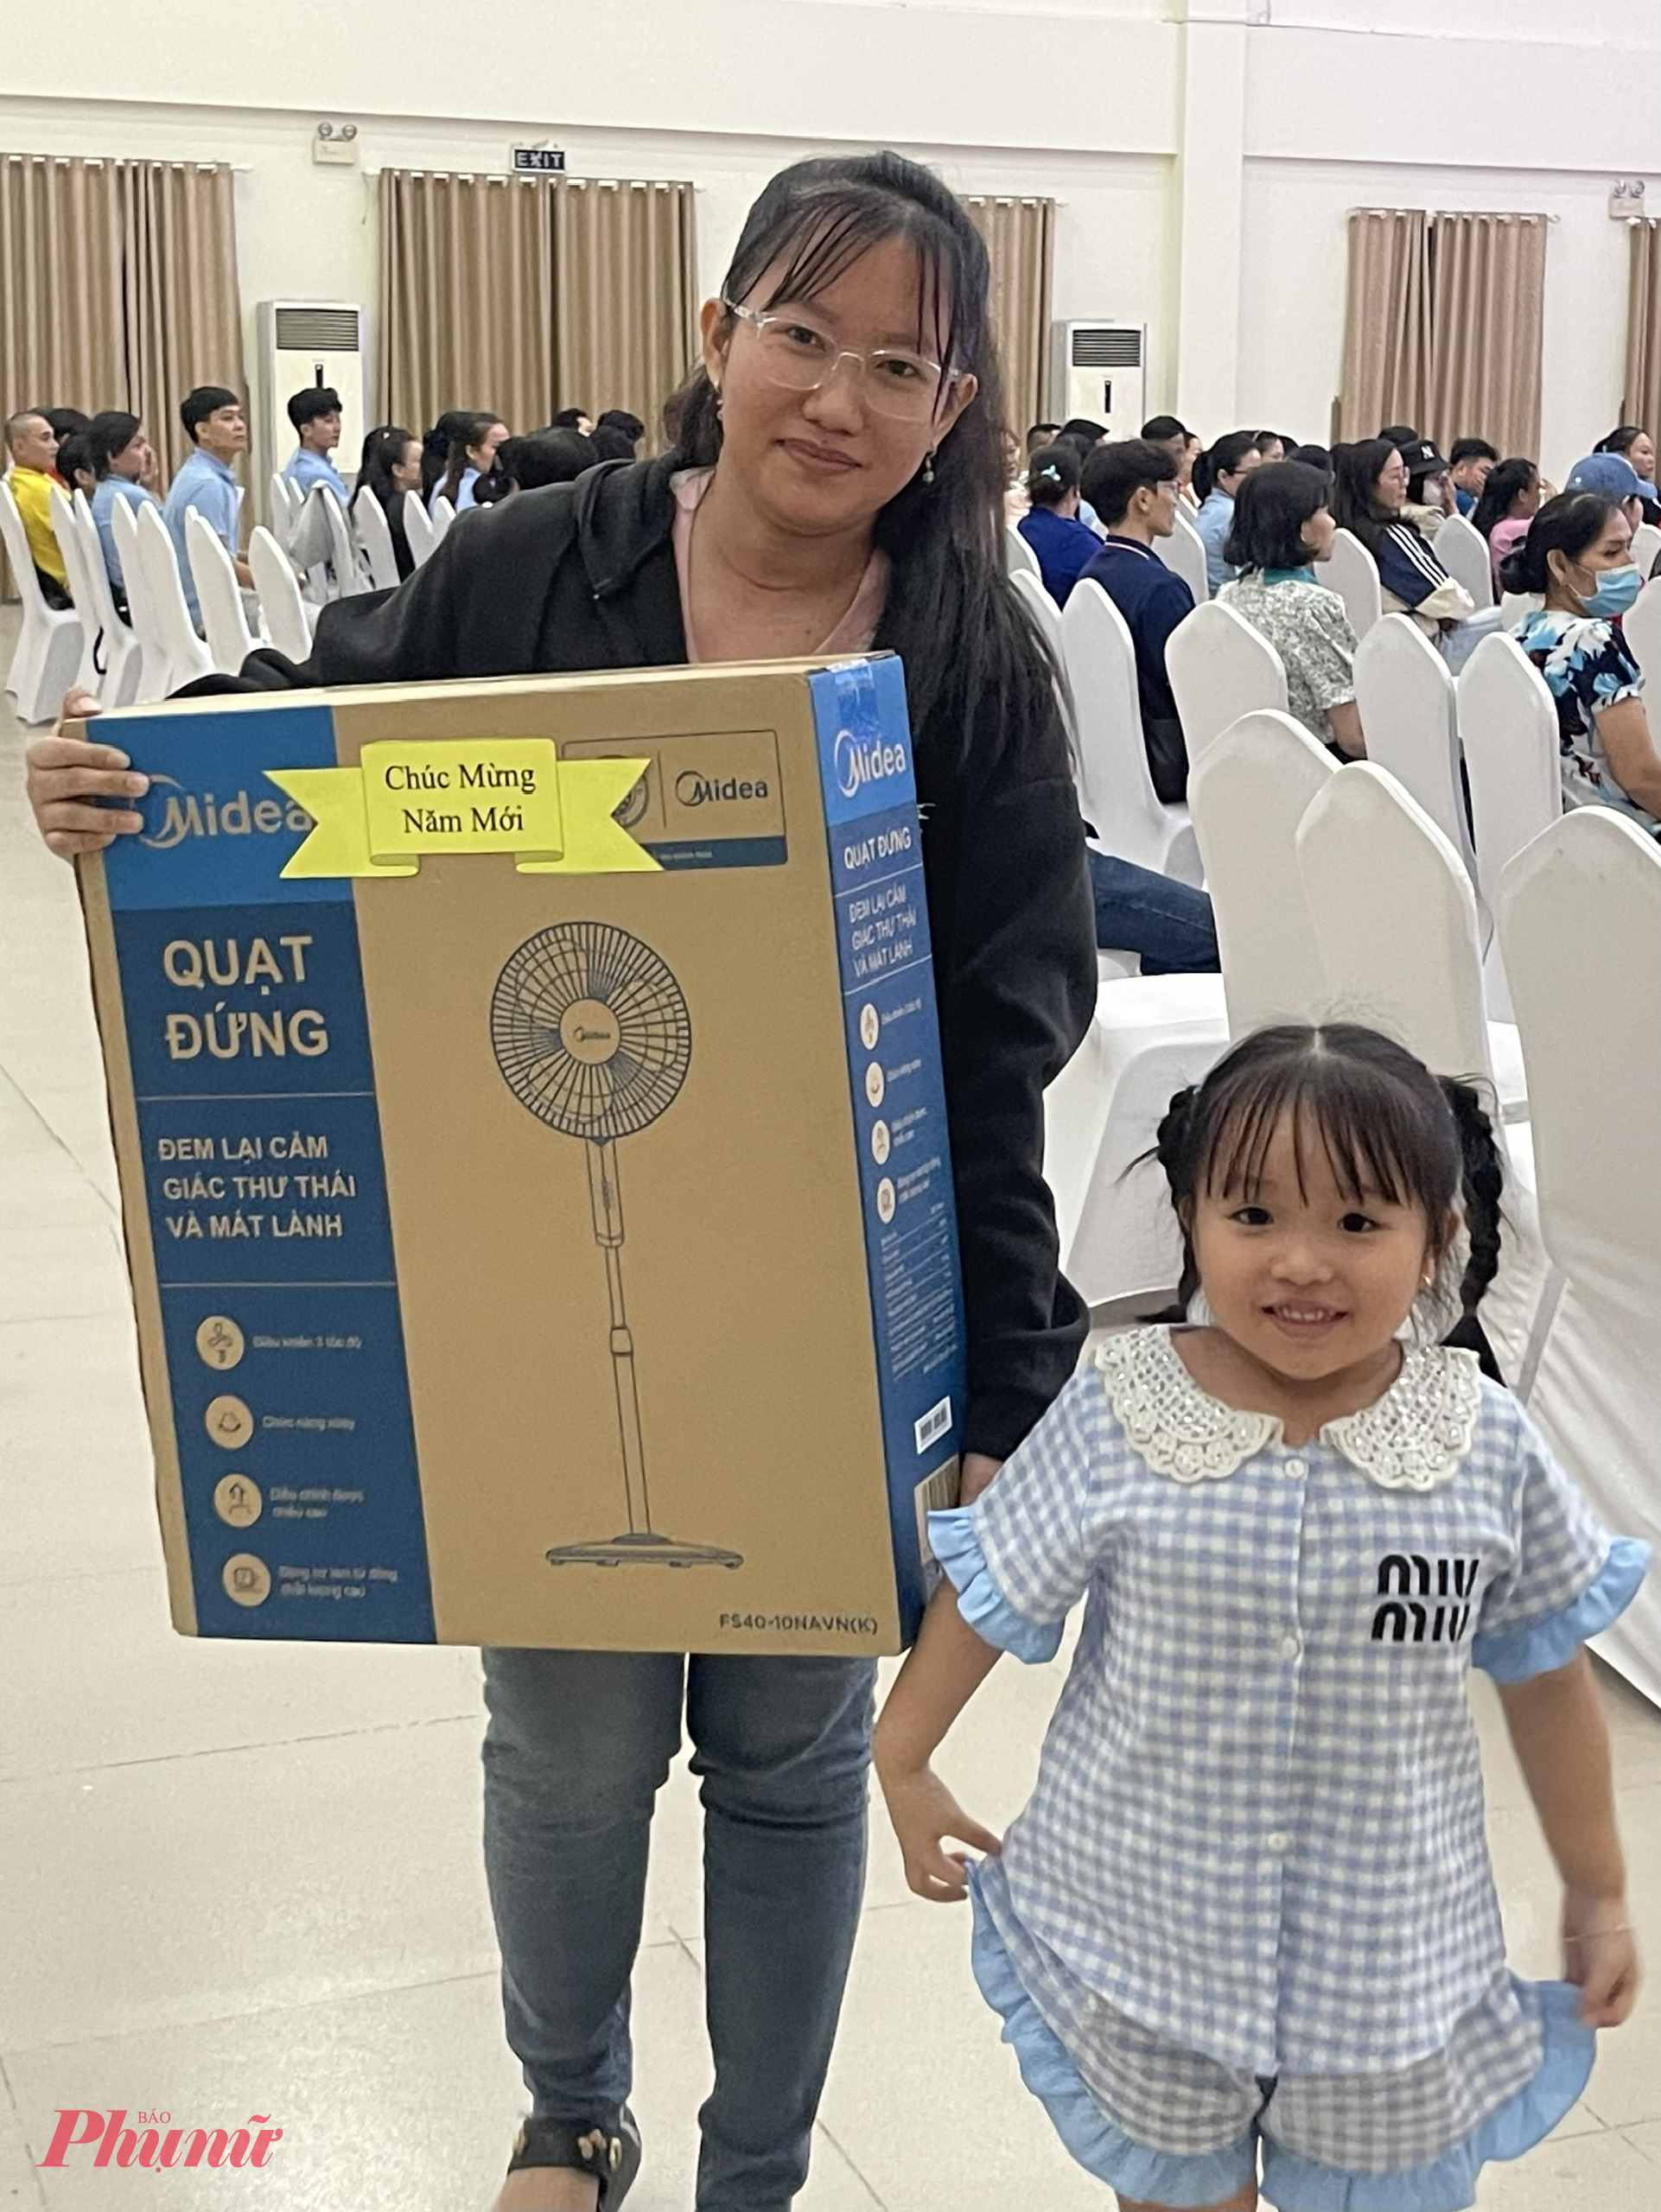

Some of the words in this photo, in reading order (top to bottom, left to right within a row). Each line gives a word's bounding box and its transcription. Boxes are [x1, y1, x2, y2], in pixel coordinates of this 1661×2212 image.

[517, 152, 563, 168] EXIT
[385, 765, 450, 790] Chúc
[458, 762, 536, 794] Mừng
[836, 729, 907, 798] Midea
[676, 771, 768, 807] Midea
[143, 773, 313, 849] Midea
[402, 808, 462, 833] Năm
[470, 804, 524, 832] Mới
[163, 936, 313, 995] QUẠT
[165, 1001, 328, 1059] ĐỨNG
[158, 1138, 214, 1161] ĐEM
[221, 1136, 263, 1165] LẠI
[163, 1172, 226, 1200] GIÁC
[232, 1175, 289, 1199] THƯ
[294, 1169, 356, 1198] THÁI
[165, 1211, 204, 1238] VÀ
[209, 1209, 264, 1237] MÁT
[271, 1210, 343, 1237] LÀNH
